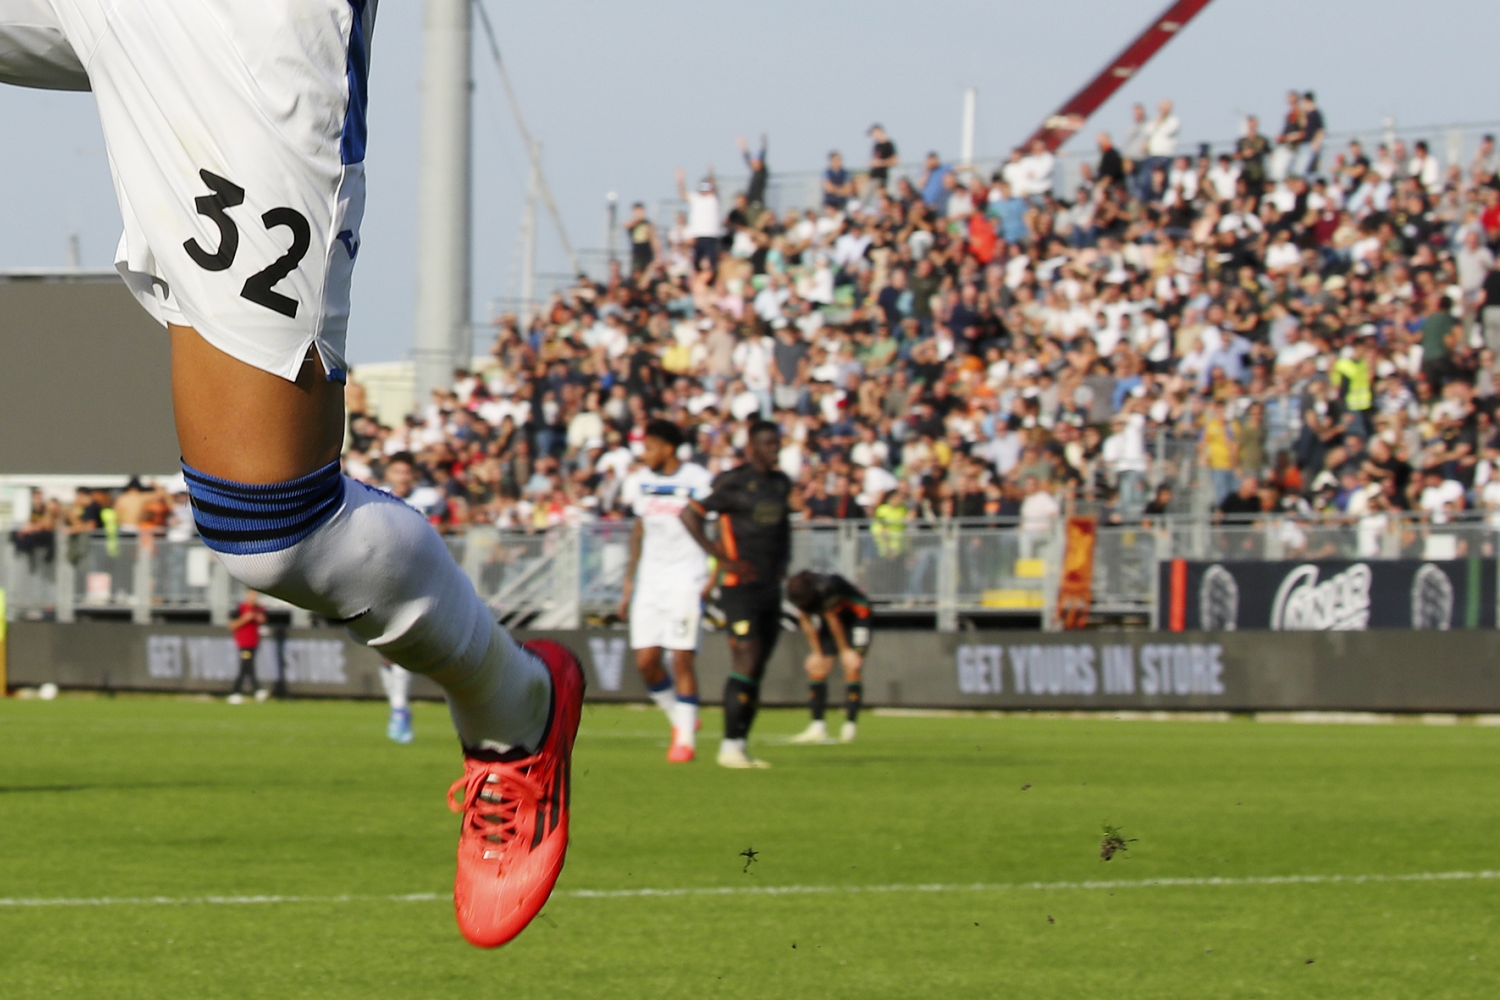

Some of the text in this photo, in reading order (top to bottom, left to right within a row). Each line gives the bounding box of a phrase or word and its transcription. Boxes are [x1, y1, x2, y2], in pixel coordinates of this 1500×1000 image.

[182, 168, 312, 320] 32
[957, 643, 1225, 696] GET YOURS IN STORE
